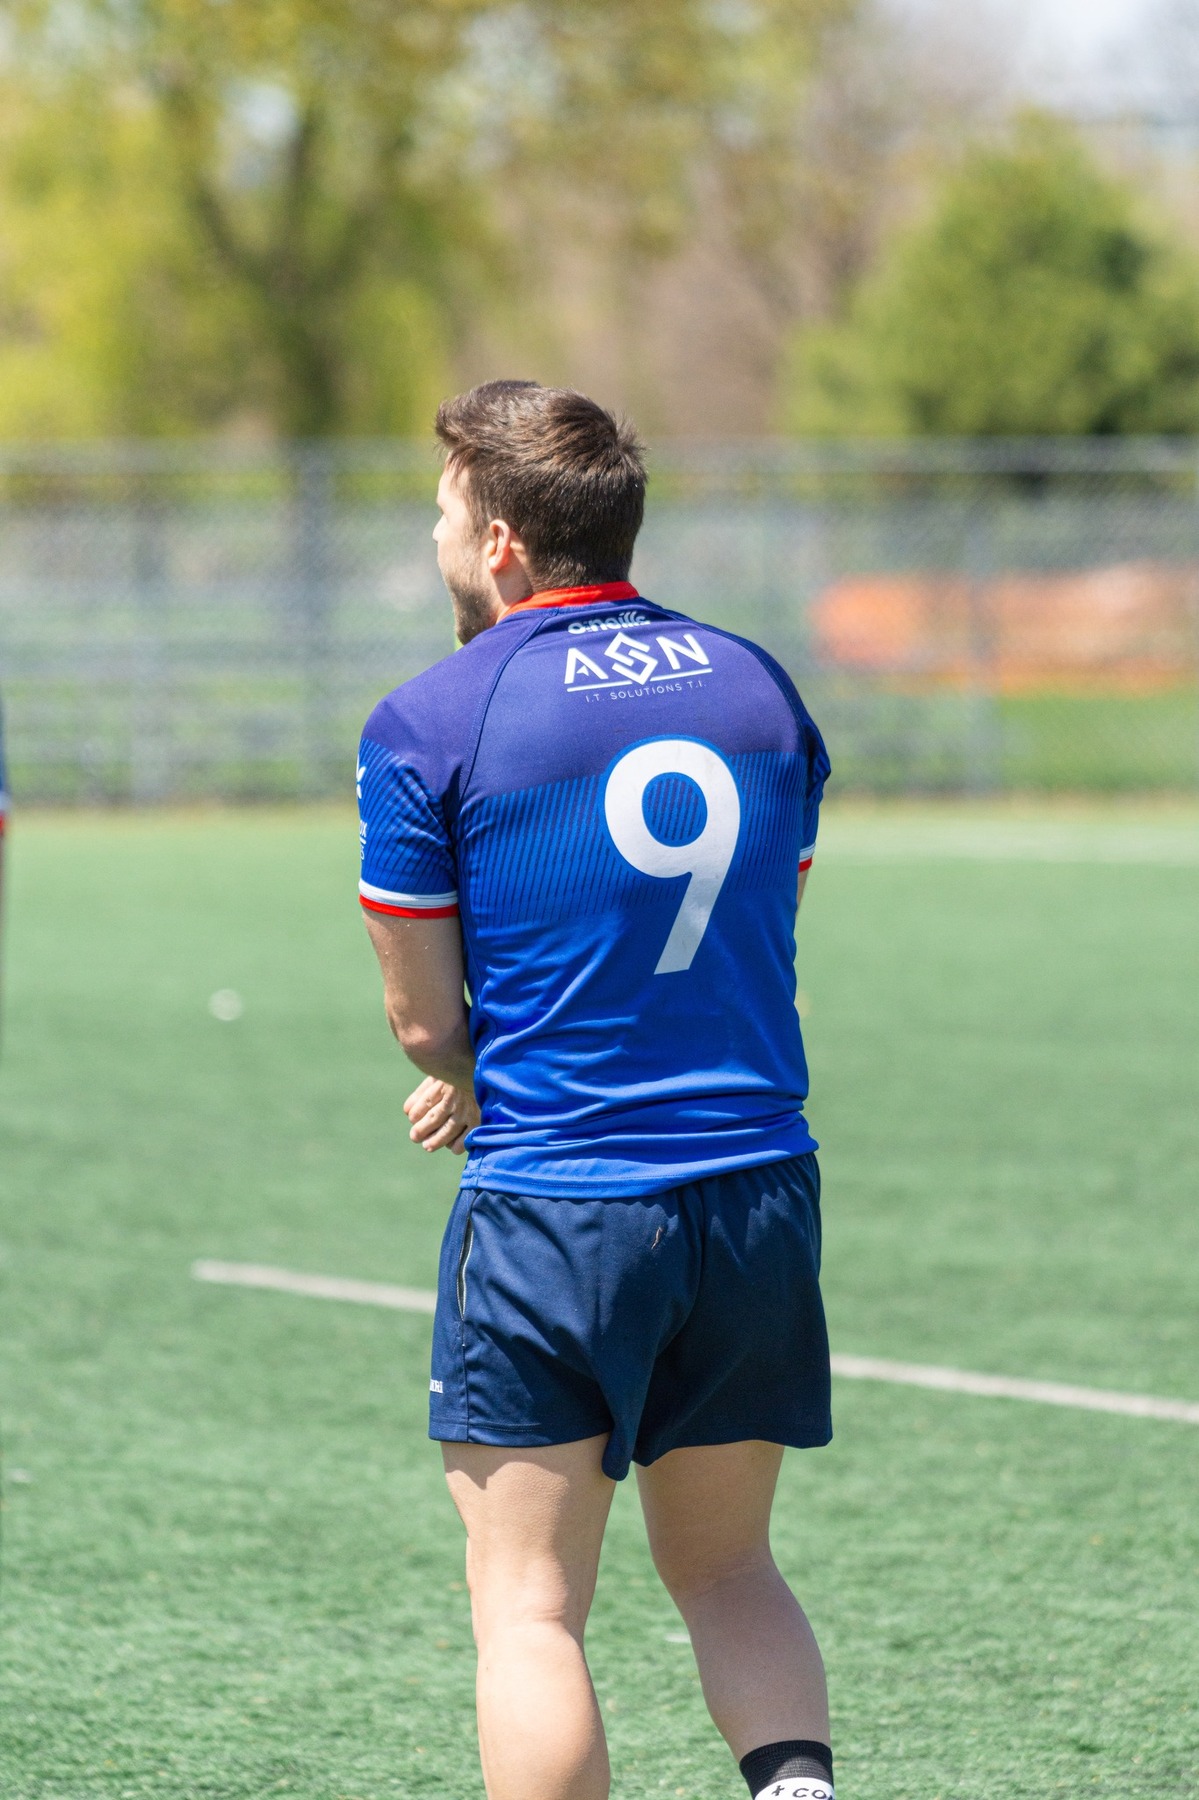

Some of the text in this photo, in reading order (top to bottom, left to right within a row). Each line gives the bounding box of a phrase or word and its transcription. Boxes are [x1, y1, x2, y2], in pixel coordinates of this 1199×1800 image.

[564, 632, 710, 684] ASN
[585, 693, 605, 702] I.T.
[610, 683, 682, 700] SOLUTIONS
[604, 739, 741, 974] 9
